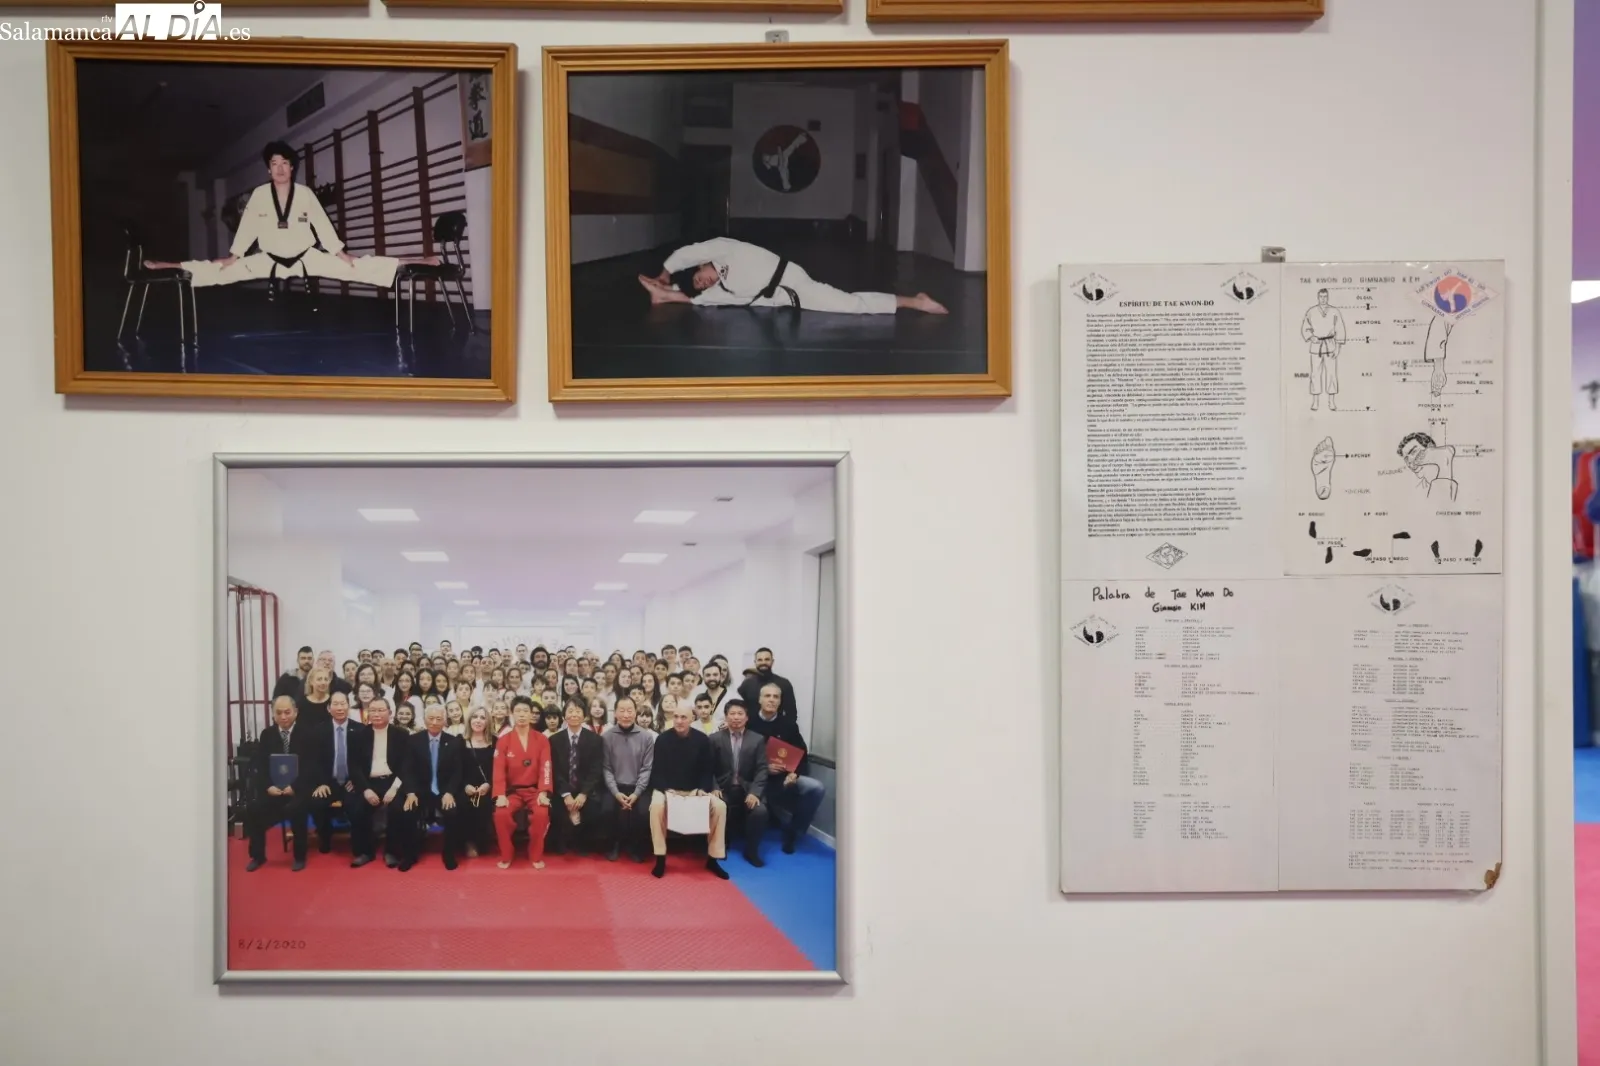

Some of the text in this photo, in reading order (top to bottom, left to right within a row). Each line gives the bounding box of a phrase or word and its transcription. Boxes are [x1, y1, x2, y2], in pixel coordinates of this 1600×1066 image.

[1092, 586, 1130, 602] Palabra
[1144, 585, 1156, 599] de
[1170, 588, 1187, 600] Tae
[1223, 587, 1234, 597] Do
[1190, 601, 1206, 611] KIM
